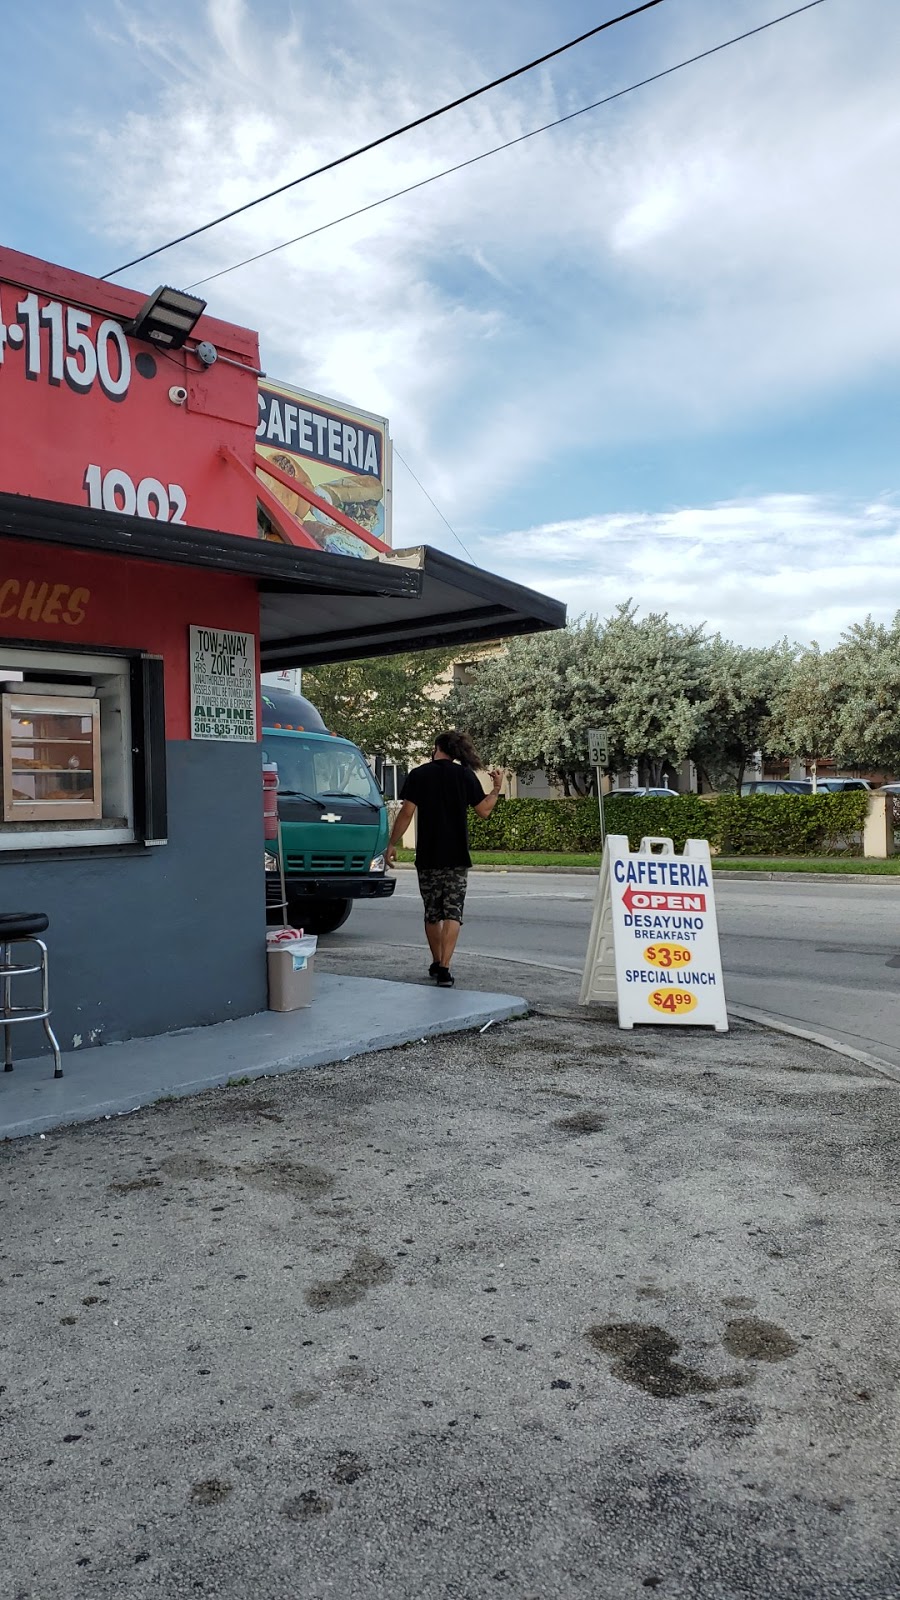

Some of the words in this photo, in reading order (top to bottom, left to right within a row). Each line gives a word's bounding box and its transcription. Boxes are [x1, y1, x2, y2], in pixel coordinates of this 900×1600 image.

[255, 393, 379, 475] CAFETERIA
[84, 464, 187, 526] 1002
[0, 579, 91, 625] CHES
[197, 630, 247, 656] TOW-AWAY
[195, 651, 204, 662] 24
[242, 657, 248, 667] 7
[193, 662, 206, 674] HRS
[211, 654, 235, 676] ZONE
[238, 667, 251, 678] DAYS
[195, 674, 225, 686] UNAUTHORIZED
[226, 676, 244, 688] VEHICLES
[193, 684, 211, 695] VESSELS
[211, 685, 221, 696] WILL
[222, 686, 227, 697] BE
[228, 687, 242, 698] TOWED
[233, 698, 251, 709] EXPENSE
[194, 706, 254, 720] ALPINE
[194, 723, 254, 735] 305-835-7003
[592, 748, 607, 762] 35
[614, 860, 709, 887] CAFETERIA
[631, 894, 701, 910] OPEN
[624, 914, 704, 930] DESAYUNO
[634, 929, 697, 941] BREAKFAST
[625, 969, 674, 984] SPECIAL
[677, 971, 716, 985] LUNCH
